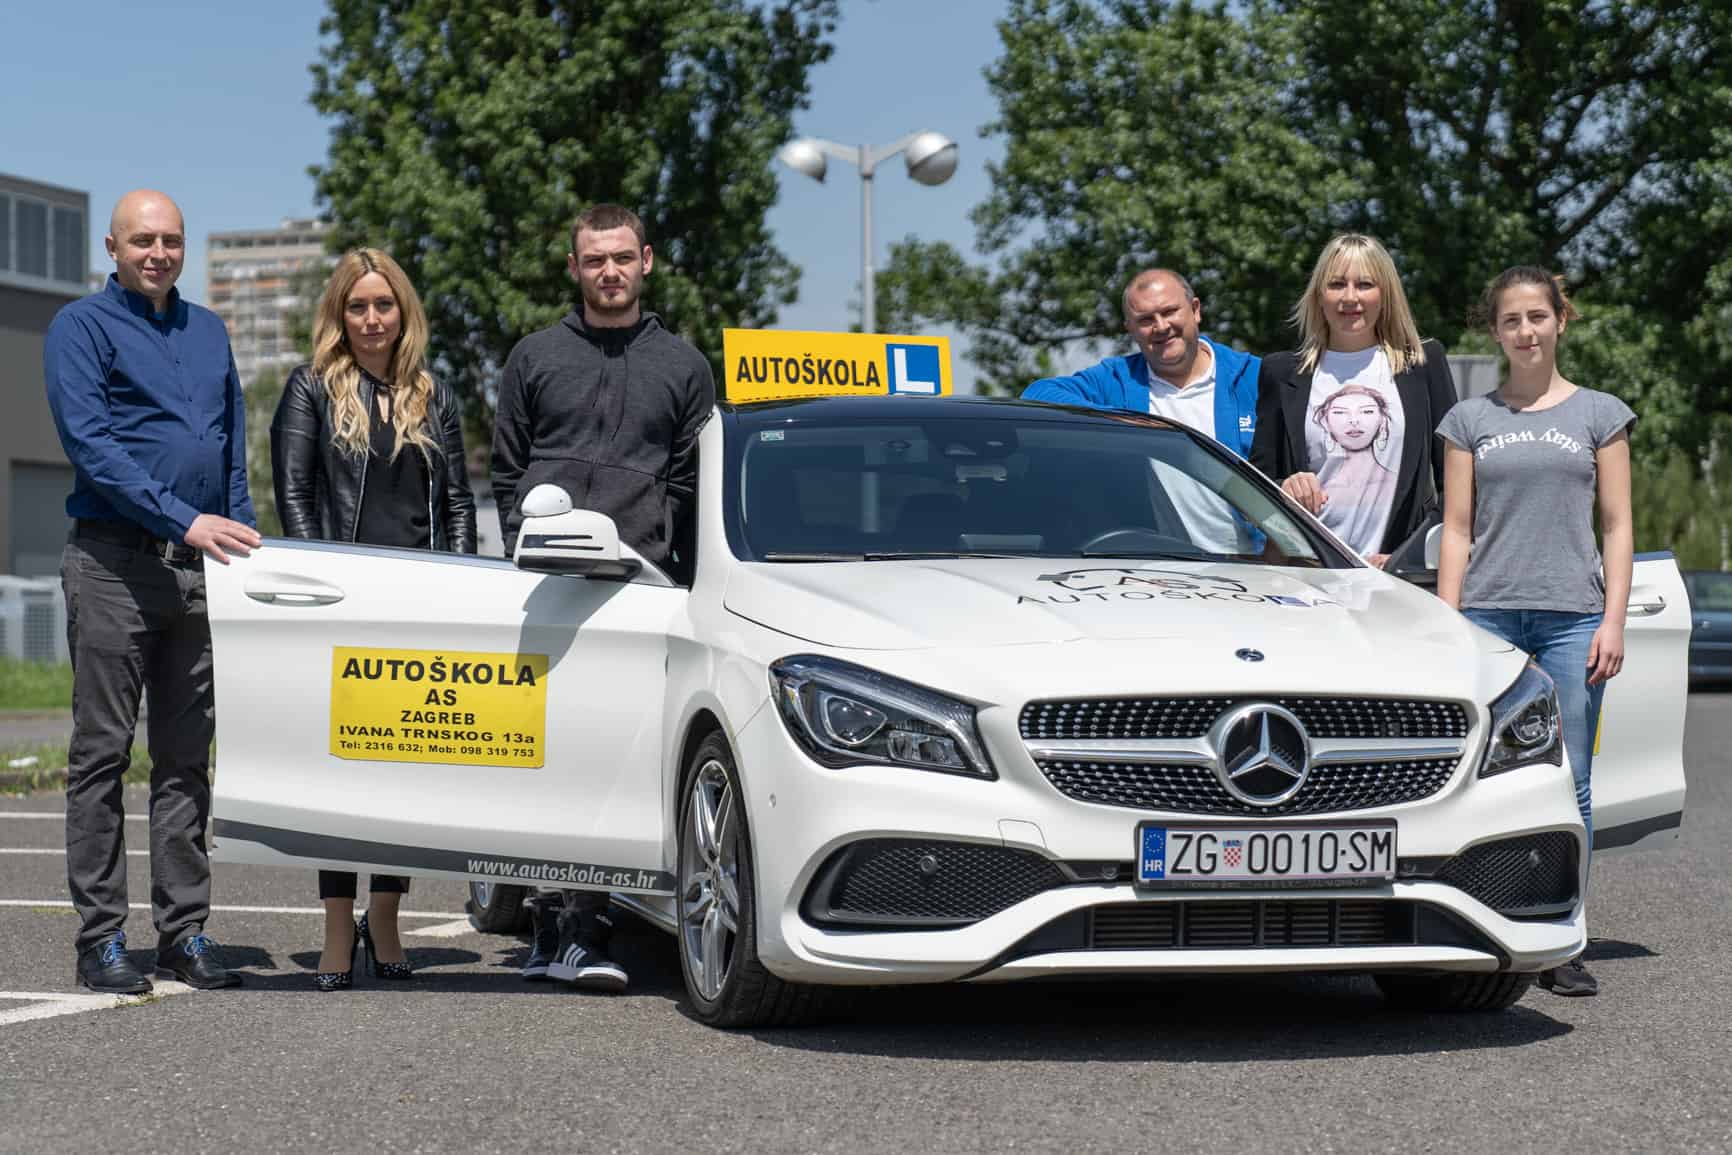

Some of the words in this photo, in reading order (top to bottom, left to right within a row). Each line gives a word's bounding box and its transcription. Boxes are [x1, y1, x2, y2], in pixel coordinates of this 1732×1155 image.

[736, 353, 881, 388] AUTOŠKOLA
[893, 347, 936, 393] L
[1477, 430, 1536, 460] weird
[1539, 427, 1582, 454] stay
[342, 656, 536, 686] AUTOŠKOLA
[424, 688, 457, 706] AS
[400, 710, 475, 725] ZAGREB
[339, 725, 395, 738] IVANA
[401, 728, 494, 742] TRNSKOG
[502, 732, 535, 744] 13a
[340, 740, 361, 750] Tel:
[365, 741, 394, 751] 2316
[398, 743, 424, 753] 632;
[428, 744, 456, 754] Mob:
[460, 746, 482, 755] 098
[487, 747, 508, 756] 319
[513, 748, 535, 757] 753
[1144, 859, 1163, 872] HR
[1170, 833, 1217, 874] ZG
[467, 859, 657, 889] www.autoskola-as.hr
